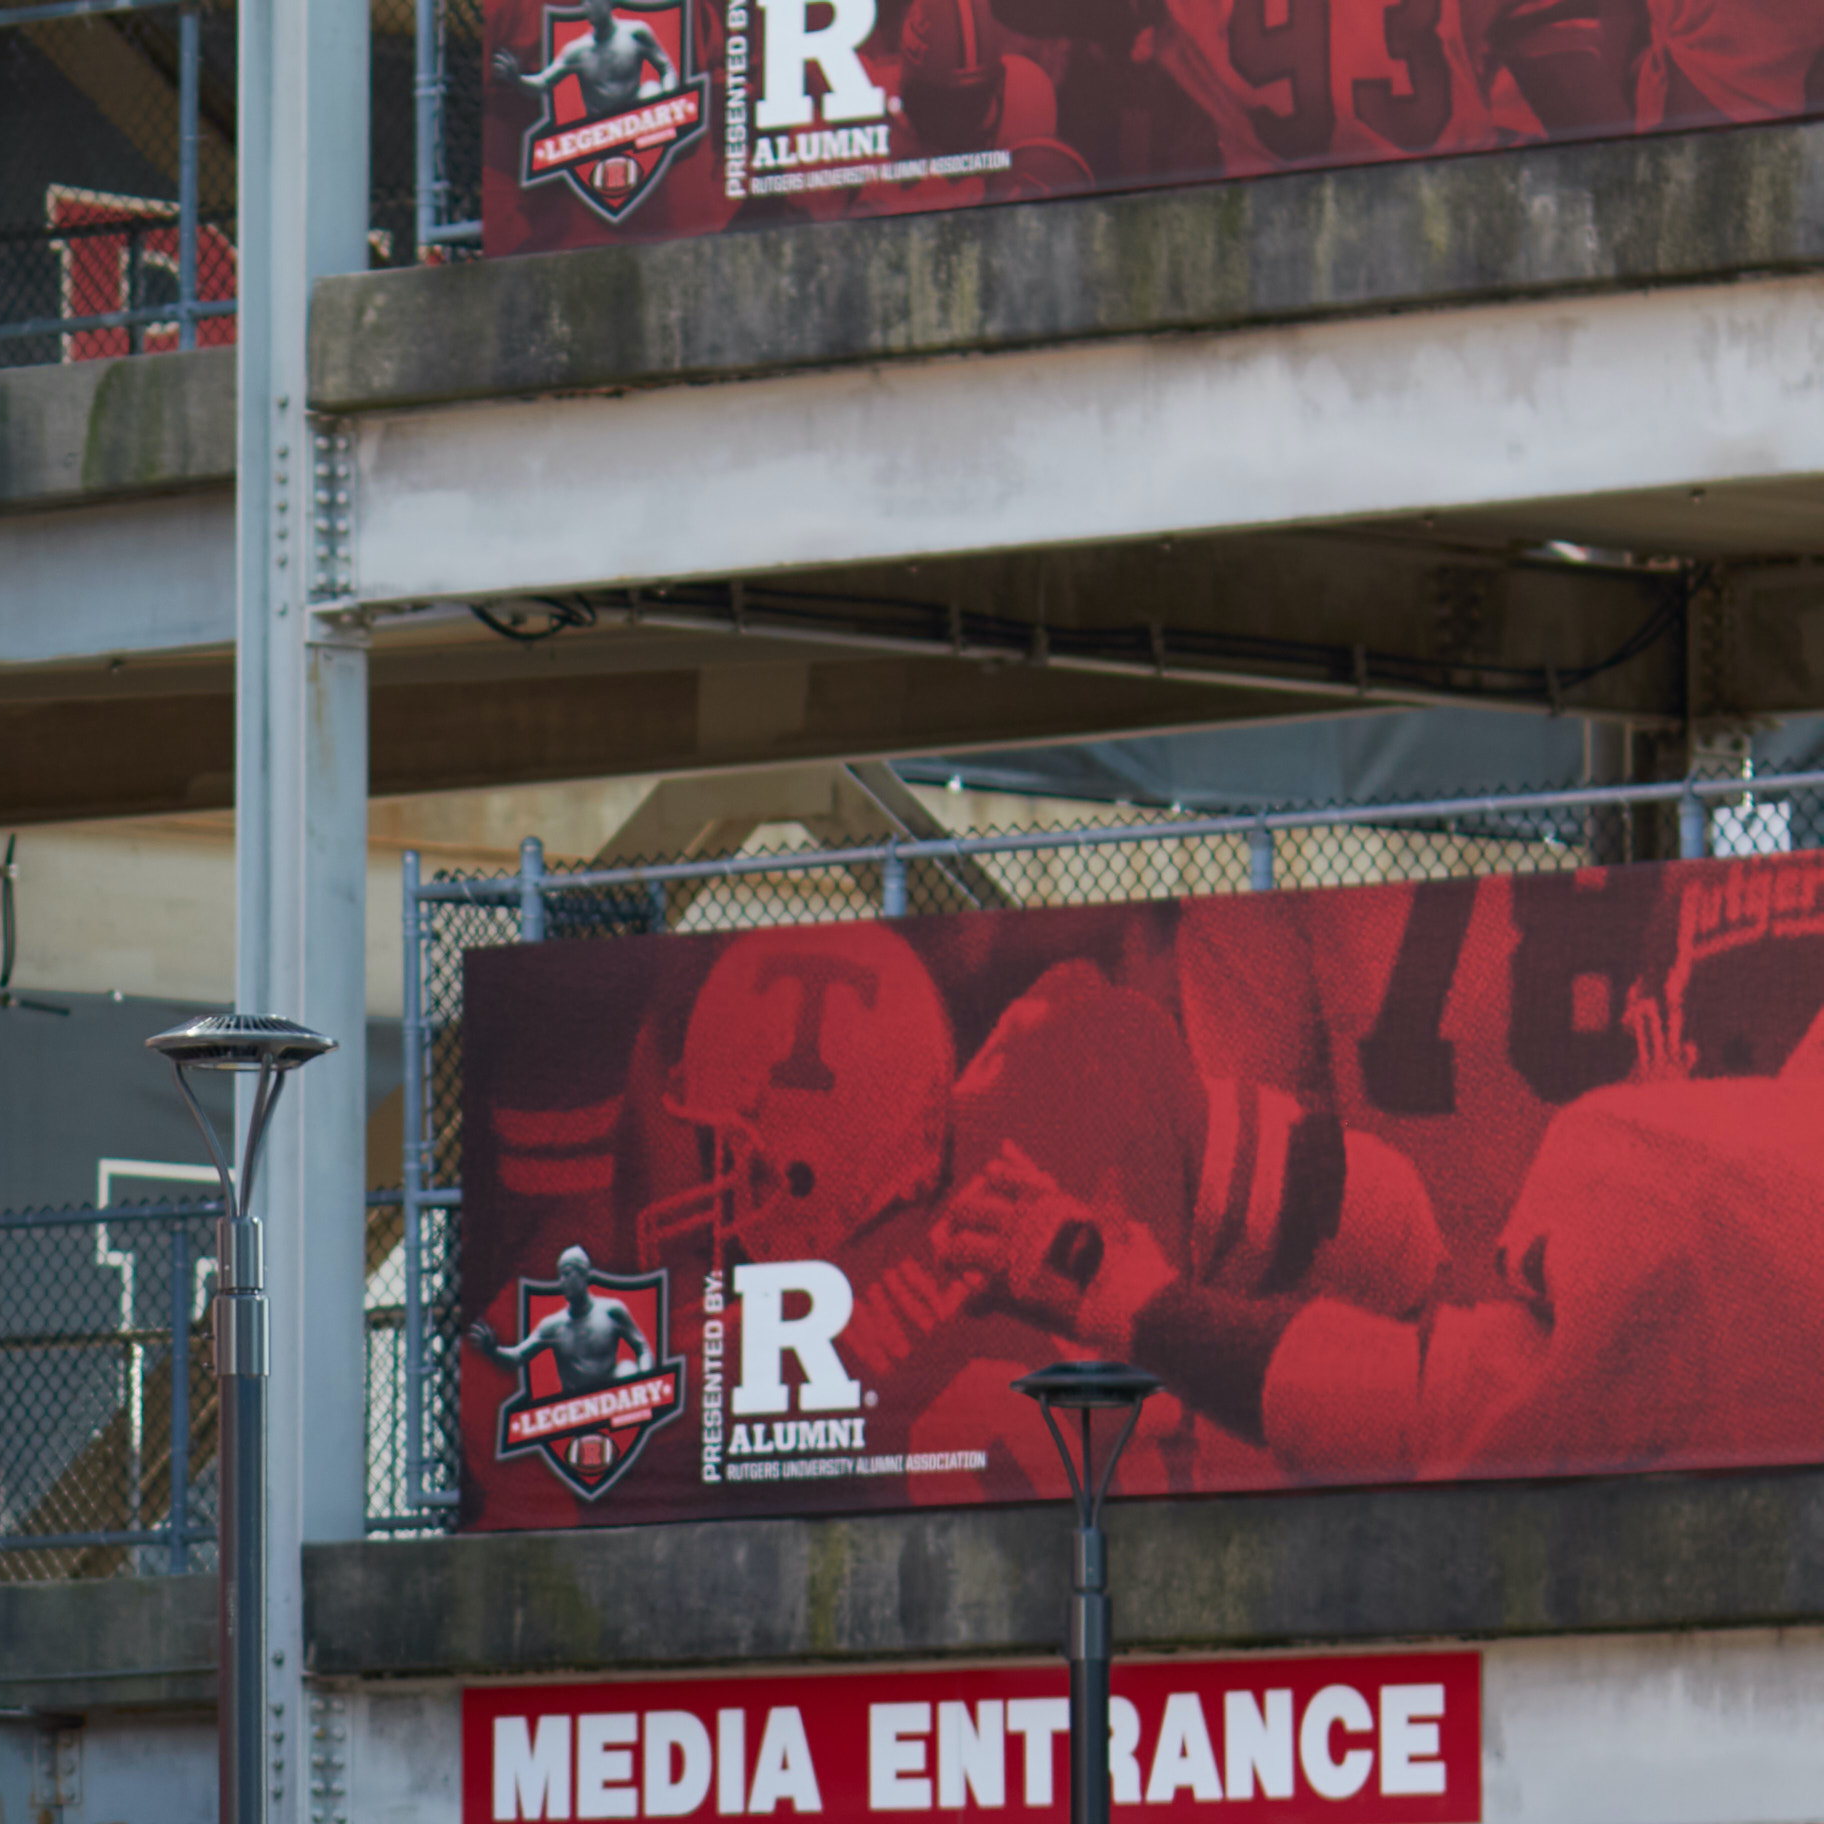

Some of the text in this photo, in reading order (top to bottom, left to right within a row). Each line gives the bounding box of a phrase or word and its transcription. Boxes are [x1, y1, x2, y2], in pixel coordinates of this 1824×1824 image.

[754, 0, 886, 129] R
[545, 97, 687, 161] LEGENDARY
[726, 36, 748, 199] PRESENTED
[752, 124, 890, 169] ALUMNI
[750, 149, 1011, 195] RUTGERS UNIVERSITY ALUMNI ASSOCIATION
[731, 1259, 861, 1415] R
[520, 1379, 664, 1436] LEGENDARY
[703, 1320, 724, 1482] PRESENTED
[726, 1450, 987, 1481] RUTGERS UNIVERSITY ALUMNI ASSOCIATION
[728, 1418, 866, 1454] ALUMNI
[492, 1706, 822, 1821] MEDIA
